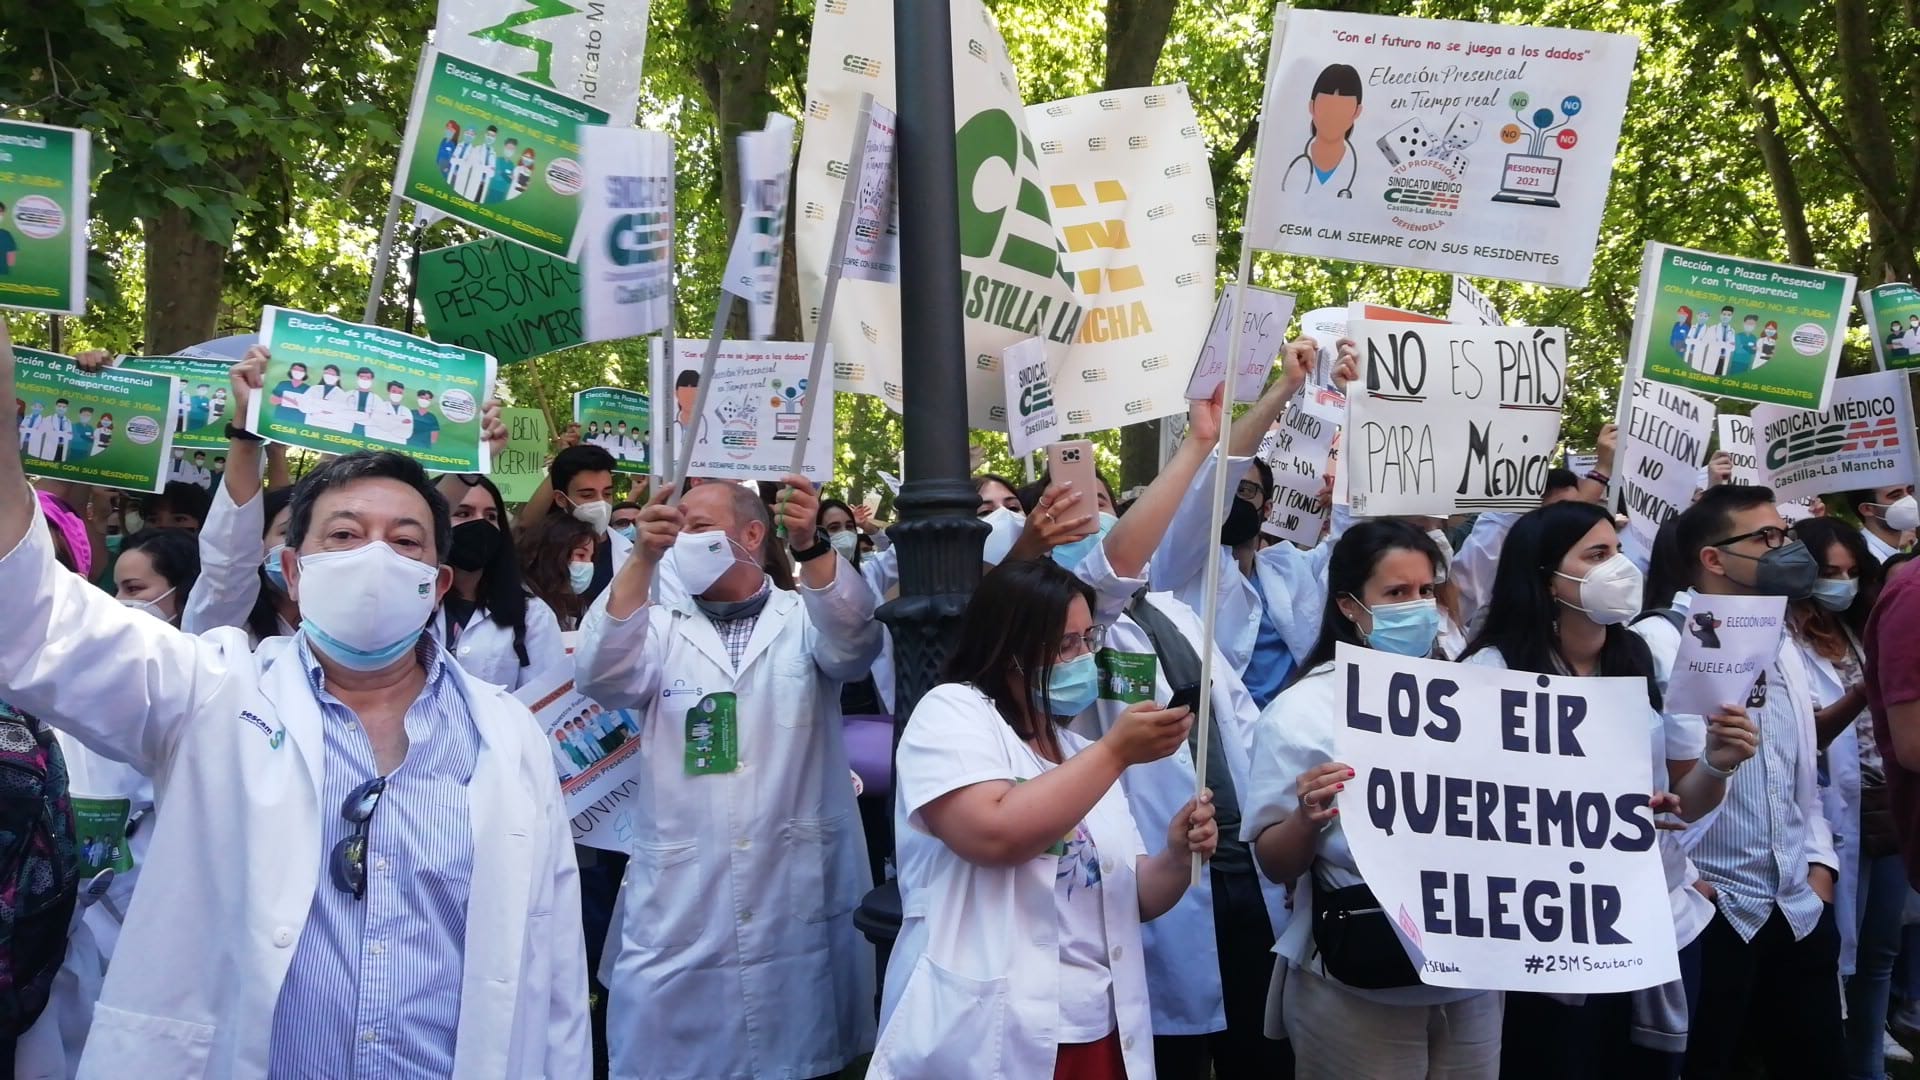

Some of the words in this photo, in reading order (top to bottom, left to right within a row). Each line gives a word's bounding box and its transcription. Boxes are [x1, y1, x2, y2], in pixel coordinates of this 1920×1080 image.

[1365, 33, 1375, 44] el
[1381, 34, 1421, 49] futuro
[1427, 40, 1441, 50] no
[1447, 42, 1461, 52] se
[1465, 41, 1501, 57] juega
[1508, 46, 1515, 55] a
[1522, 44, 1539, 57] los
[1368, 65, 1438, 87] Elección
[1440, 61, 1528, 85] Presencial
[1391, 96, 1408, 110] en
[1411, 90, 1462, 116] Tiempo
[1465, 88, 1501, 108] real
[1512, 97, 1528, 108] NO
[1563, 100, 1579, 111] NO
[1502, 128, 1518, 139] NO
[1560, 134, 1575, 145] NO
[1507, 164, 1556, 176] RESIDENTES
[1516, 176, 1540, 187] 2021
[1388, 176, 1429, 190] SINDICATO
[1431, 180, 1462, 193] MÉDICO
[1384, 188, 1460, 209] CESM
[1279, 223, 1312, 237] CESM
[1317, 228, 1342, 241] CLM
[1348, 231, 1404, 248] SIEMPRE
[1408, 239, 1436, 252] CON
[1441, 242, 1469, 255] SUS
[1473, 246, 1560, 265] RESIDENTES
[443, 239, 551, 284] SOMO
[1673, 256, 1712, 272] Elección
[1717, 265, 1729, 275] de
[1734, 267, 1767, 281] Plazas
[1771, 273, 1826, 290] Presencial
[1691, 275, 1697, 284] y
[1702, 277, 1719, 286] con
[1723, 278, 1798, 299] Transparencia
[288, 318, 339, 334] Elección
[344, 329, 359, 338] de
[364, 331, 403, 348] Plazas
[406, 341, 466, 360] Presencial
[315, 335, 323, 344] y
[328, 337, 349, 347] con
[356, 340, 439, 368] Transparencia
[48, 361, 62, 371] de
[66, 363, 97, 378] Plazas
[101, 372, 153, 387] Presencial
[1367, 330, 1427, 395] NO
[1451, 339, 1483, 400] ES
[1495, 328, 1561, 405] PAÍS
[22, 370, 28, 379] y
[33, 372, 51, 381] con
[56, 374, 130, 394] Transparencia
[1632, 381, 1653, 399] SE
[1658, 388, 1699, 424] LLAMA
[1286, 404, 1321, 440] QUIERO
[1765, 410, 1830, 443] SINDICATO
[1833, 397, 1895, 424] MÉDICO
[323, 433, 364, 449] SIEMPRE
[1275, 429, 1293, 453] SER
[1766, 417, 1899, 470] CESM
[1293, 457, 1315, 480] 404
[1362, 421, 1436, 494] PARA
[1456, 420, 1554, 498] MÉDICO
[1638, 456, 1664, 481] NO
[1775, 465, 1838, 489] Castilla-La
[1842, 458, 1895, 474] Mancha
[1689, 661, 1724, 674] HUELE
[1727, 664, 1733, 674] A
[241, 710, 273, 735] sescam
[1346, 662, 1461, 743] LOS
[1500, 675, 1587, 757] EIR
[1367, 767, 1656, 853] QUEREMOS
[1420, 861, 1633, 945] ELEGIR
